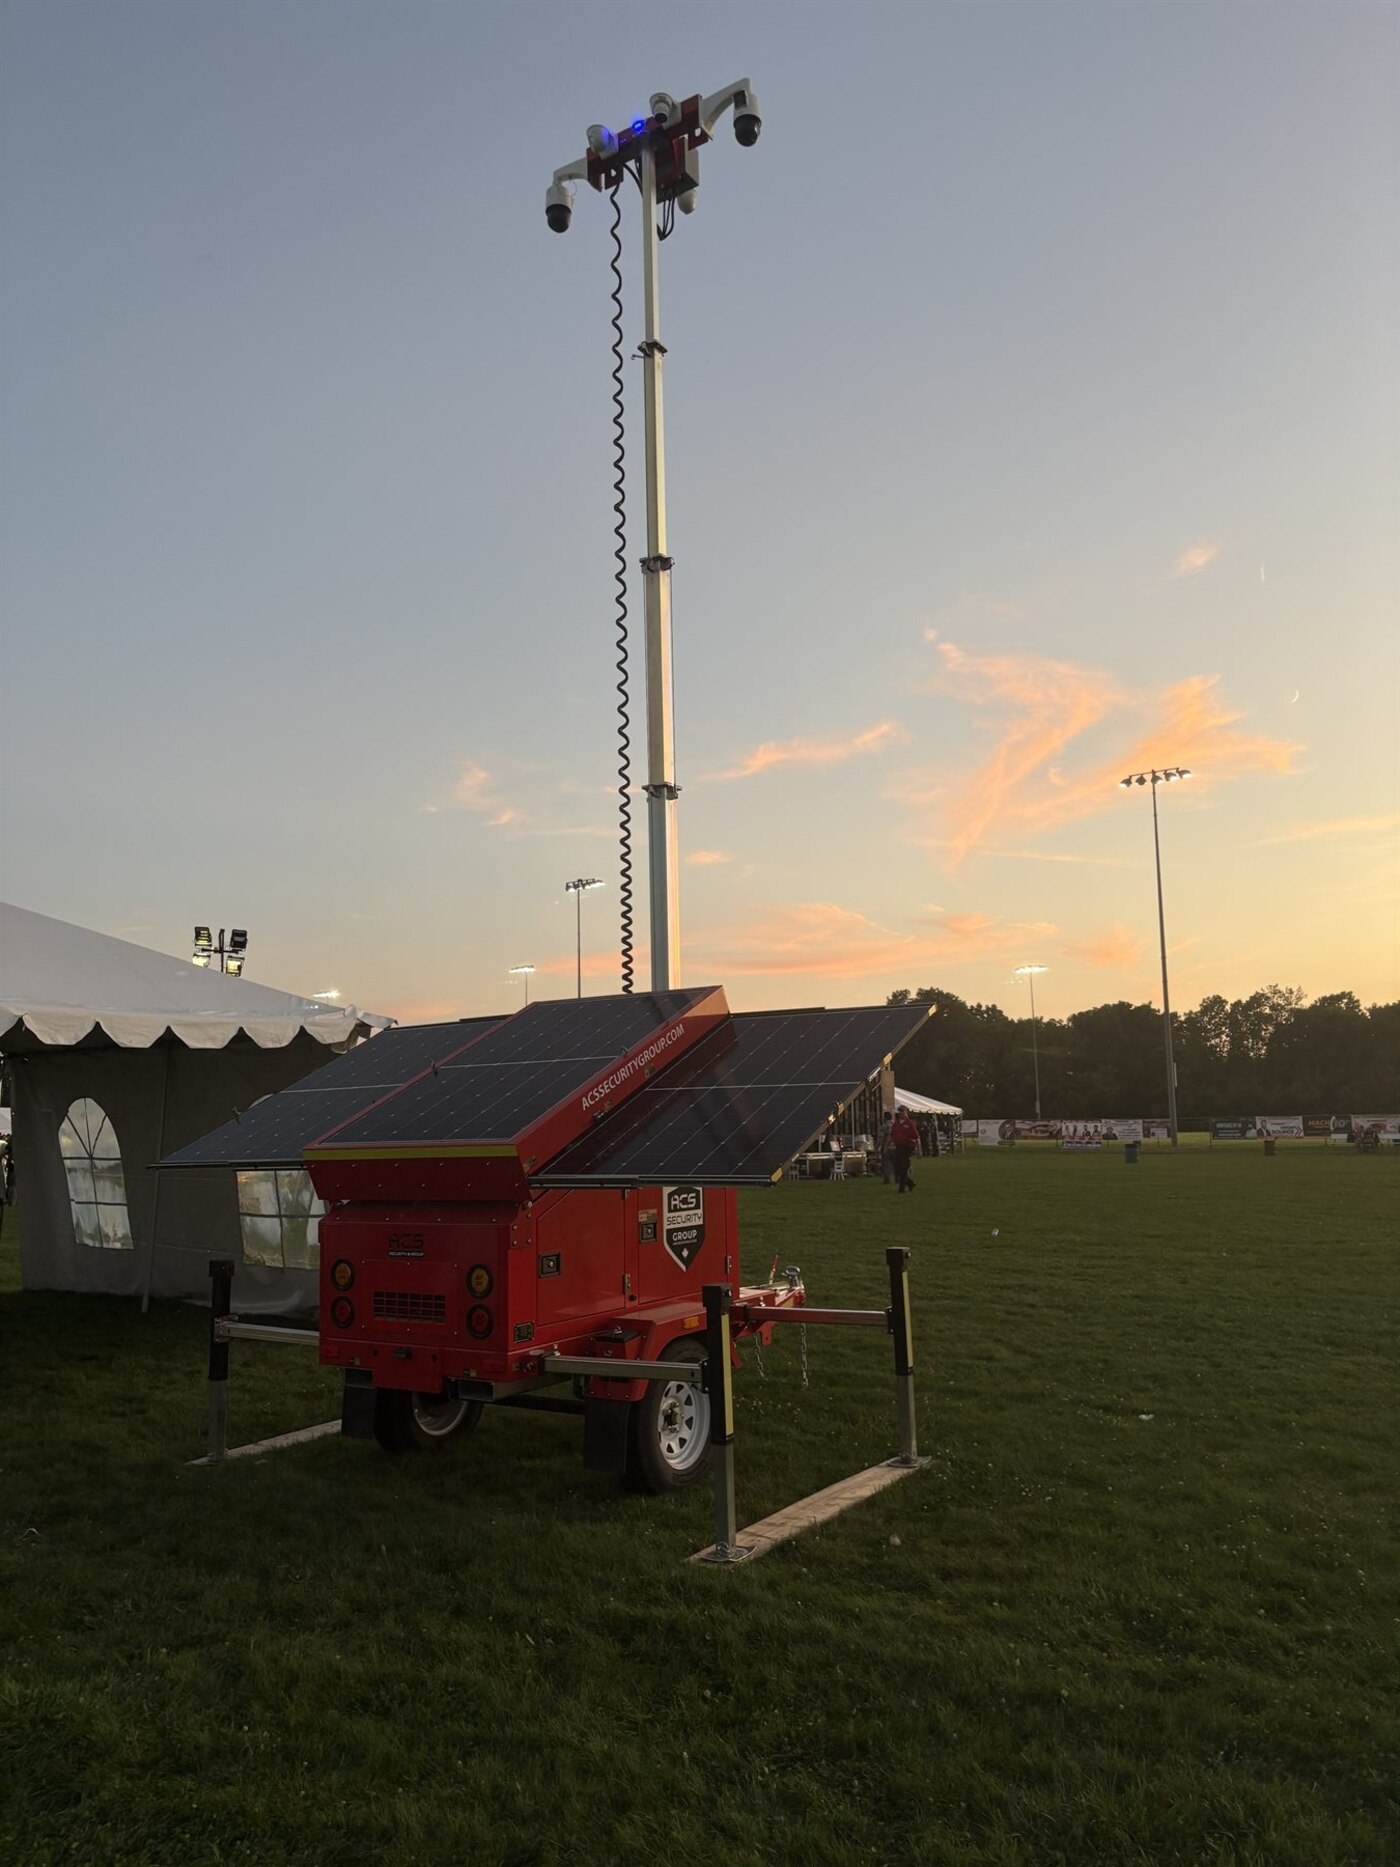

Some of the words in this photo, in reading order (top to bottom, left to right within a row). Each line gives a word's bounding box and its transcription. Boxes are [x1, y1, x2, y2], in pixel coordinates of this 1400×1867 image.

[582, 1023, 685, 1111] ACSSECURITYGROUP.COM
[670, 1193, 697, 1210] ACS
[666, 1213, 702, 1226] SECURITY
[388, 1232, 424, 1249] ACS
[672, 1229, 698, 1242] GROUP
